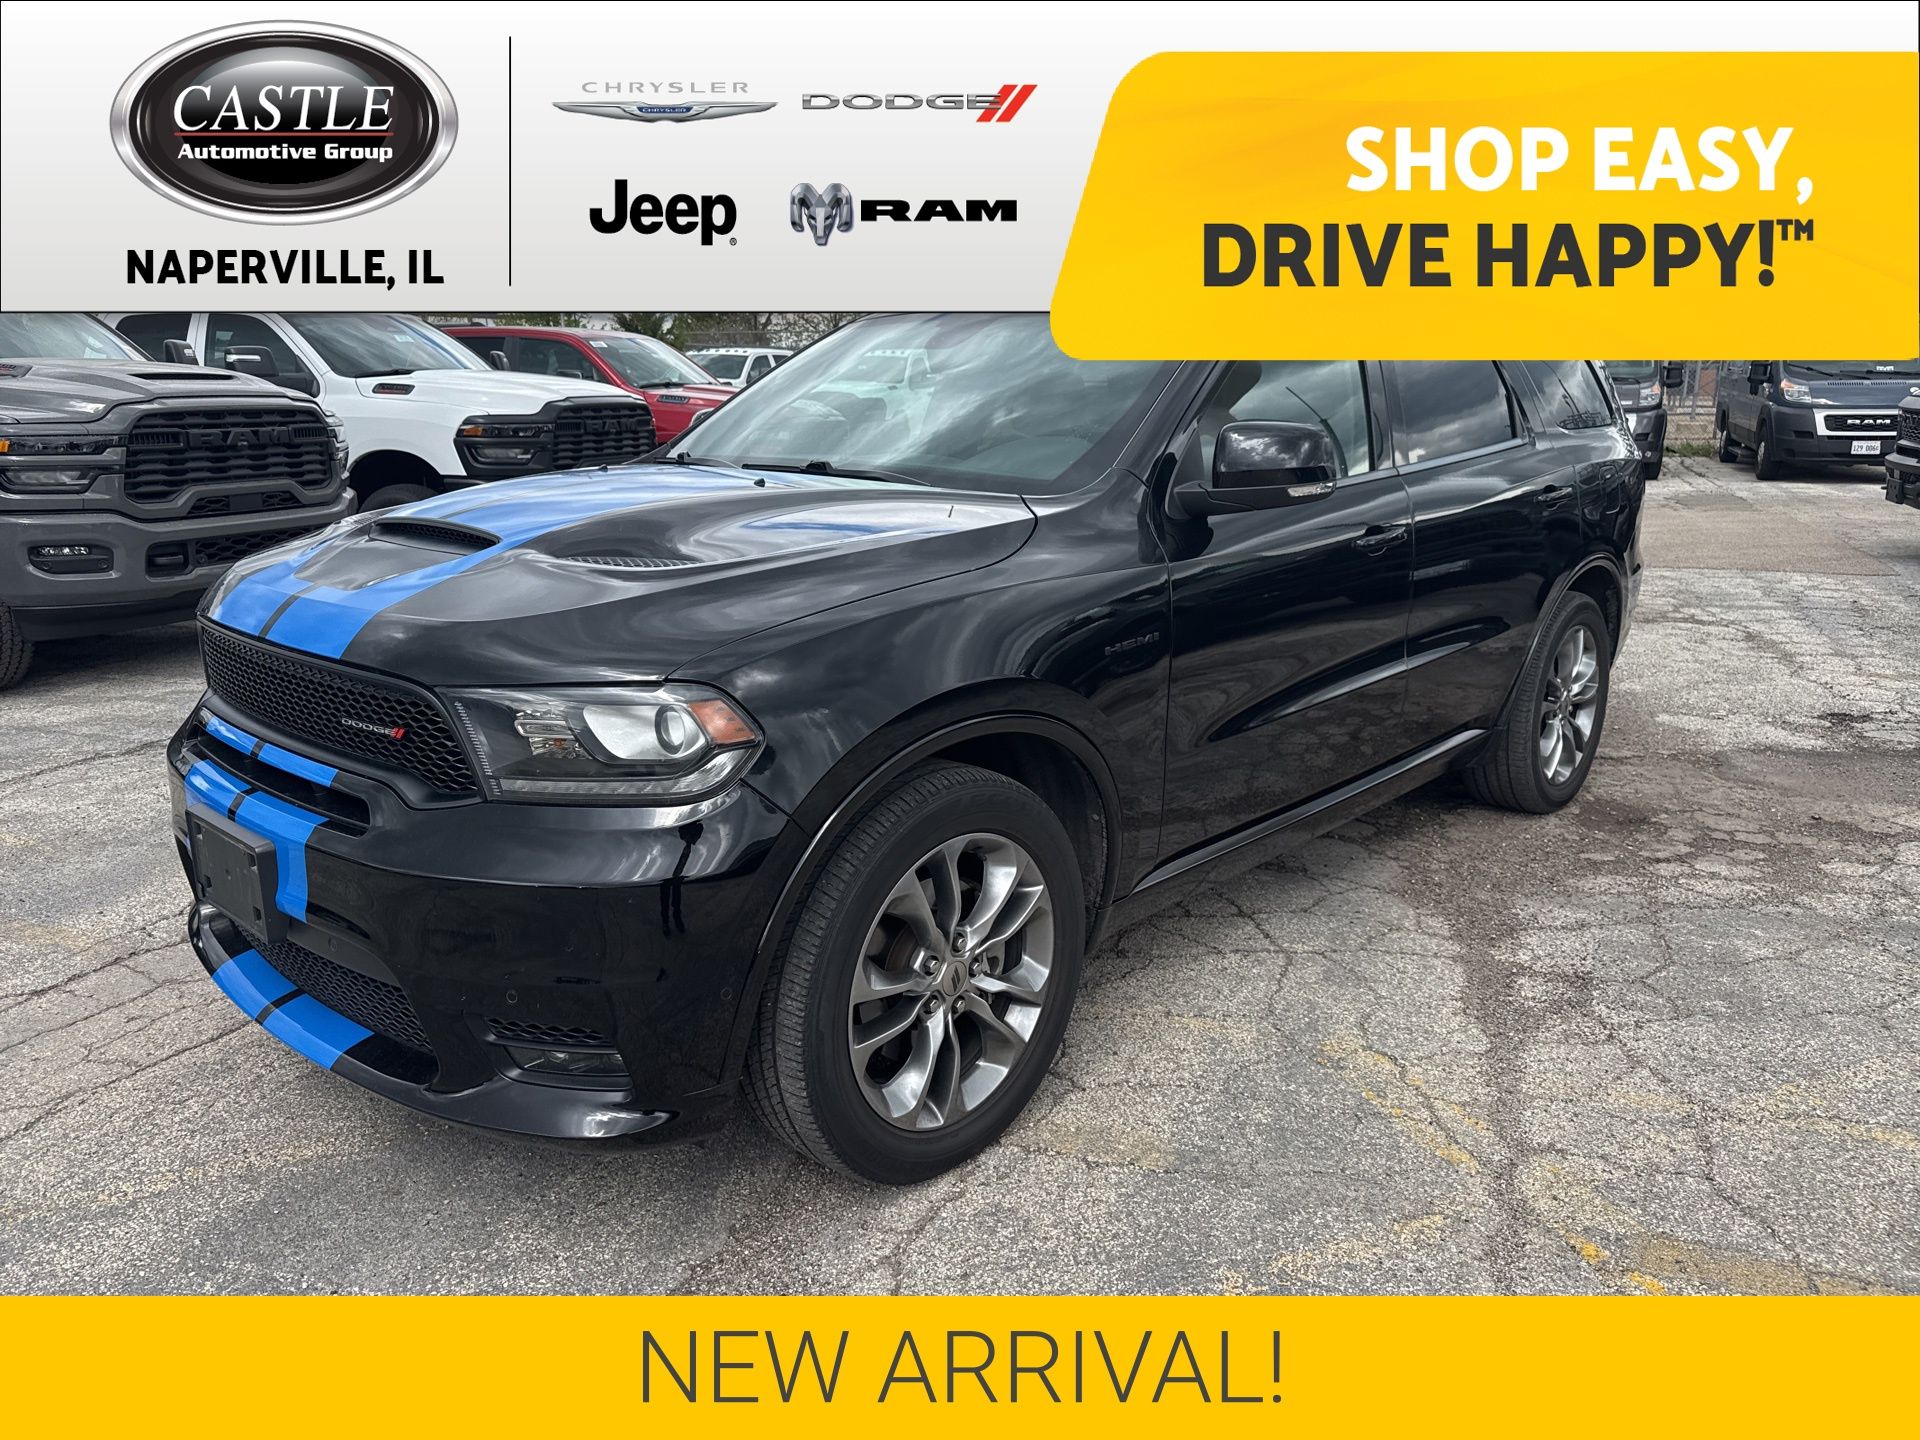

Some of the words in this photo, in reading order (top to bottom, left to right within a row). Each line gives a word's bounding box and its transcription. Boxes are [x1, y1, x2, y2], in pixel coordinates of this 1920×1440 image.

[189, 427, 289, 447] RAM
[1104, 631, 1160, 656] HEMI
[341, 717, 396, 738] DODGE
